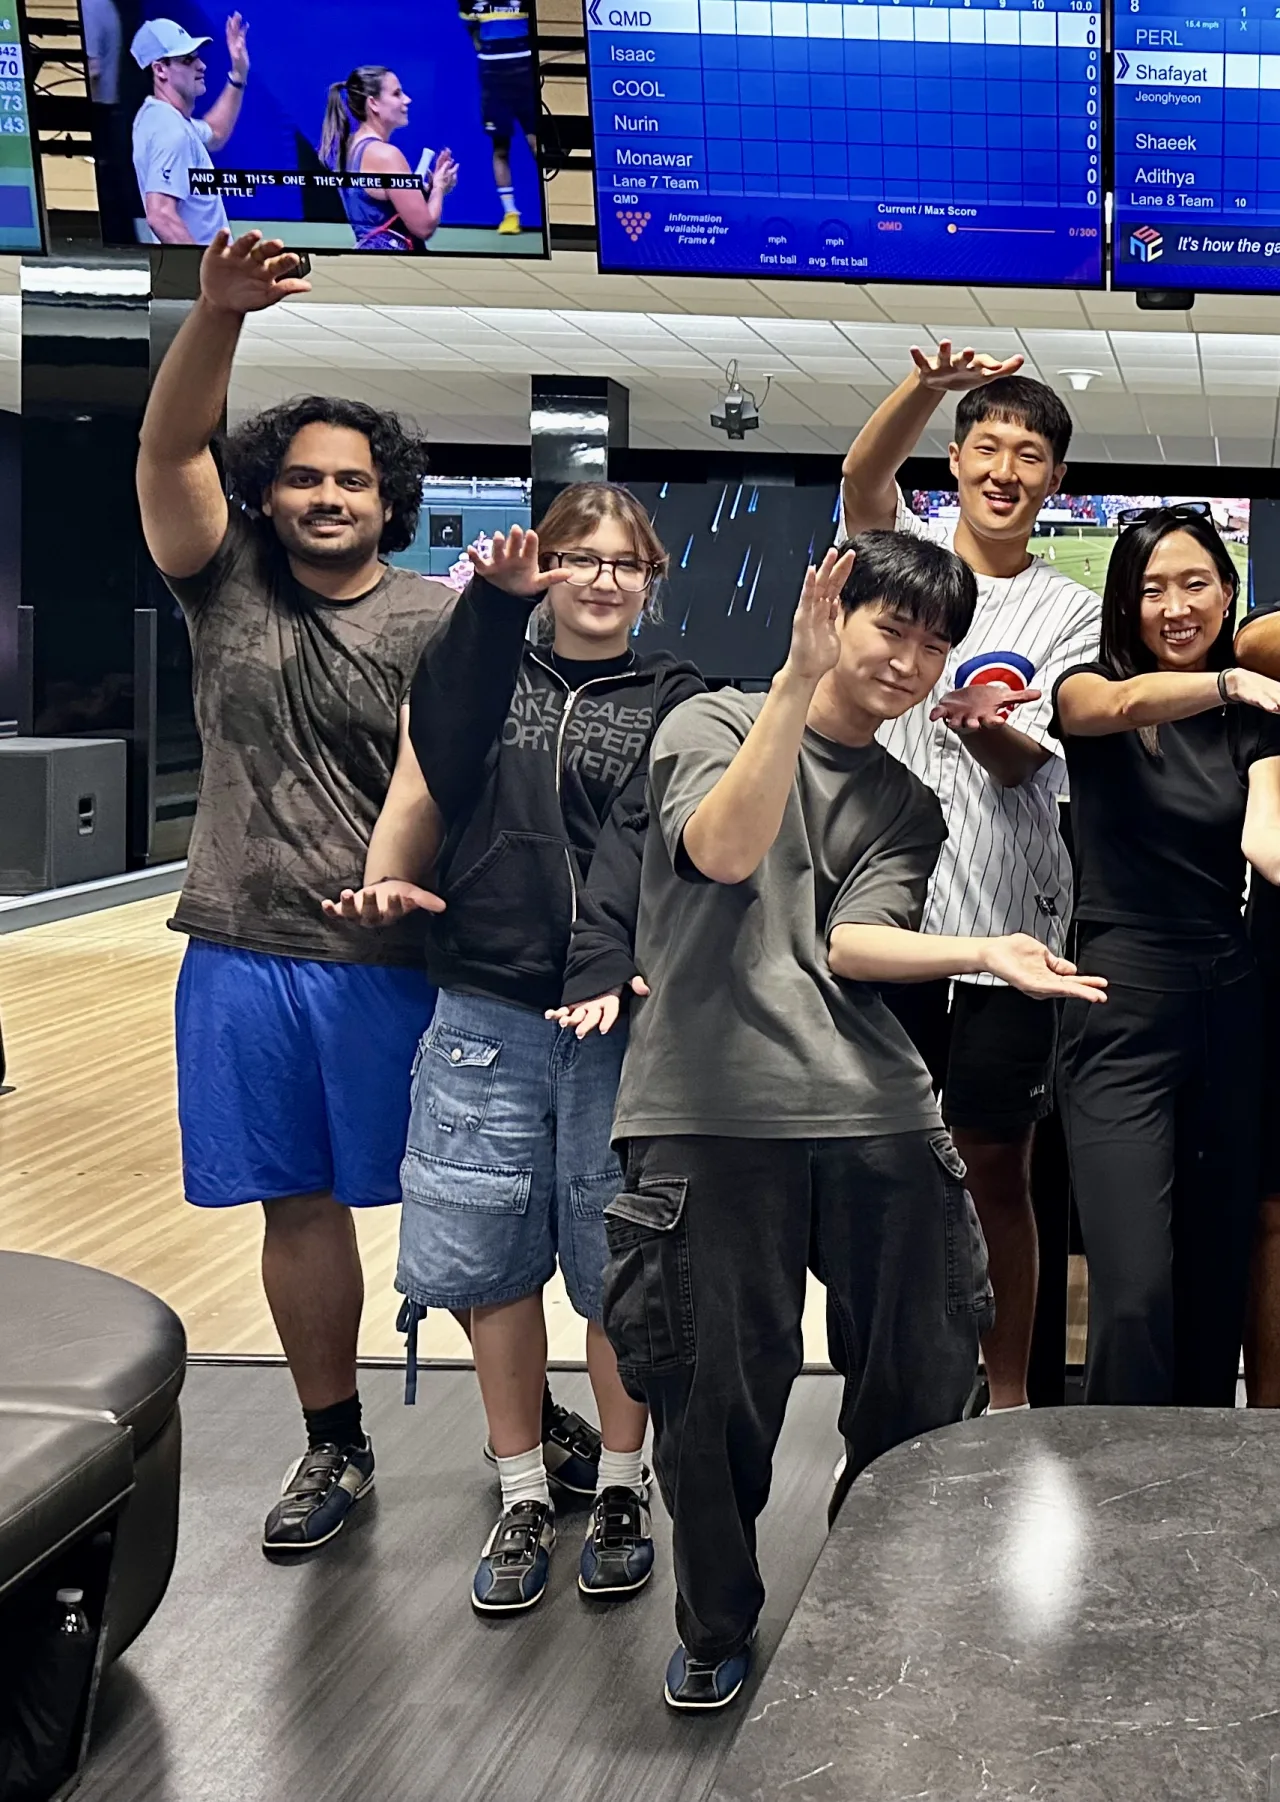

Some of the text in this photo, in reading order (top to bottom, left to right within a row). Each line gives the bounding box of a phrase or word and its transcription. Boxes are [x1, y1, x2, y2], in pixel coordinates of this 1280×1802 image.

[1032, 0, 1045, 10] 10
[1070, 0, 1092, 11] 10.0
[1130, 0, 1140, 12] 8
[1241, 7, 1246, 17] 1
[608, 10, 652, 27] QMD
[1089, 15, 1096, 26] 0
[1202, 21, 1219, 30] mph
[1086, 30, 1096, 45] 0
[1136, 29, 1184, 46] PERL
[0, 46, 17, 56] 42
[611, 45, 656, 62] Isaac
[1089, 50, 1097, 61] 0
[0, 60, 18, 76] 70
[1086, 65, 1096, 81] 0
[1136, 64, 1207, 85] Shafayat
[0, 81, 21, 92] 382
[612, 80, 665, 97] COOL
[1089, 86, 1097, 96] 0
[1, 94, 23, 111] 73
[1135, 91, 1201, 105] Jeonghyeon
[1086, 100, 1096, 115] 0
[614, 114, 658, 132] Nurin
[1089, 120, 1097, 130] 0
[1087, 134, 1097, 150] 0
[1136, 133, 1197, 151] Shaeek
[616, 149, 693, 167] Monawar
[1090, 154, 1097, 165] 0
[191, 173, 420, 188] AND IN THIS ONE THEY WERE JUST
[613, 174, 699, 190] Lane 7 Team
[1087, 168, 1097, 184] 0
[1135, 168, 1195, 188] Adithya
[192, 186, 253, 198] A LITTLE
[1087, 190, 1097, 205] 0
[613, 194, 639, 204] QMD
[1131, 192, 1246, 207] Lane 8 Team 10
[877, 203, 916, 214] Current
[924, 205, 945, 215] Max
[947, 207, 977, 216] Score
[669, 213, 722, 223] Information
[664, 224, 729, 235] available after
[877, 221, 902, 231] QMD
[1069, 228, 1098, 237] 0/300
[678, 235, 715, 245] Frame 4
[768, 236, 787, 245] mph
[825, 237, 844, 247] mph
[1178, 236, 1199, 251] It's
[1202, 237, 1234, 252] how
[1237, 238, 1261, 253] the
[760, 253, 797, 264] first ball
[808, 256, 868, 268] avg. first ball
[565, 719, 646, 758] SPER
